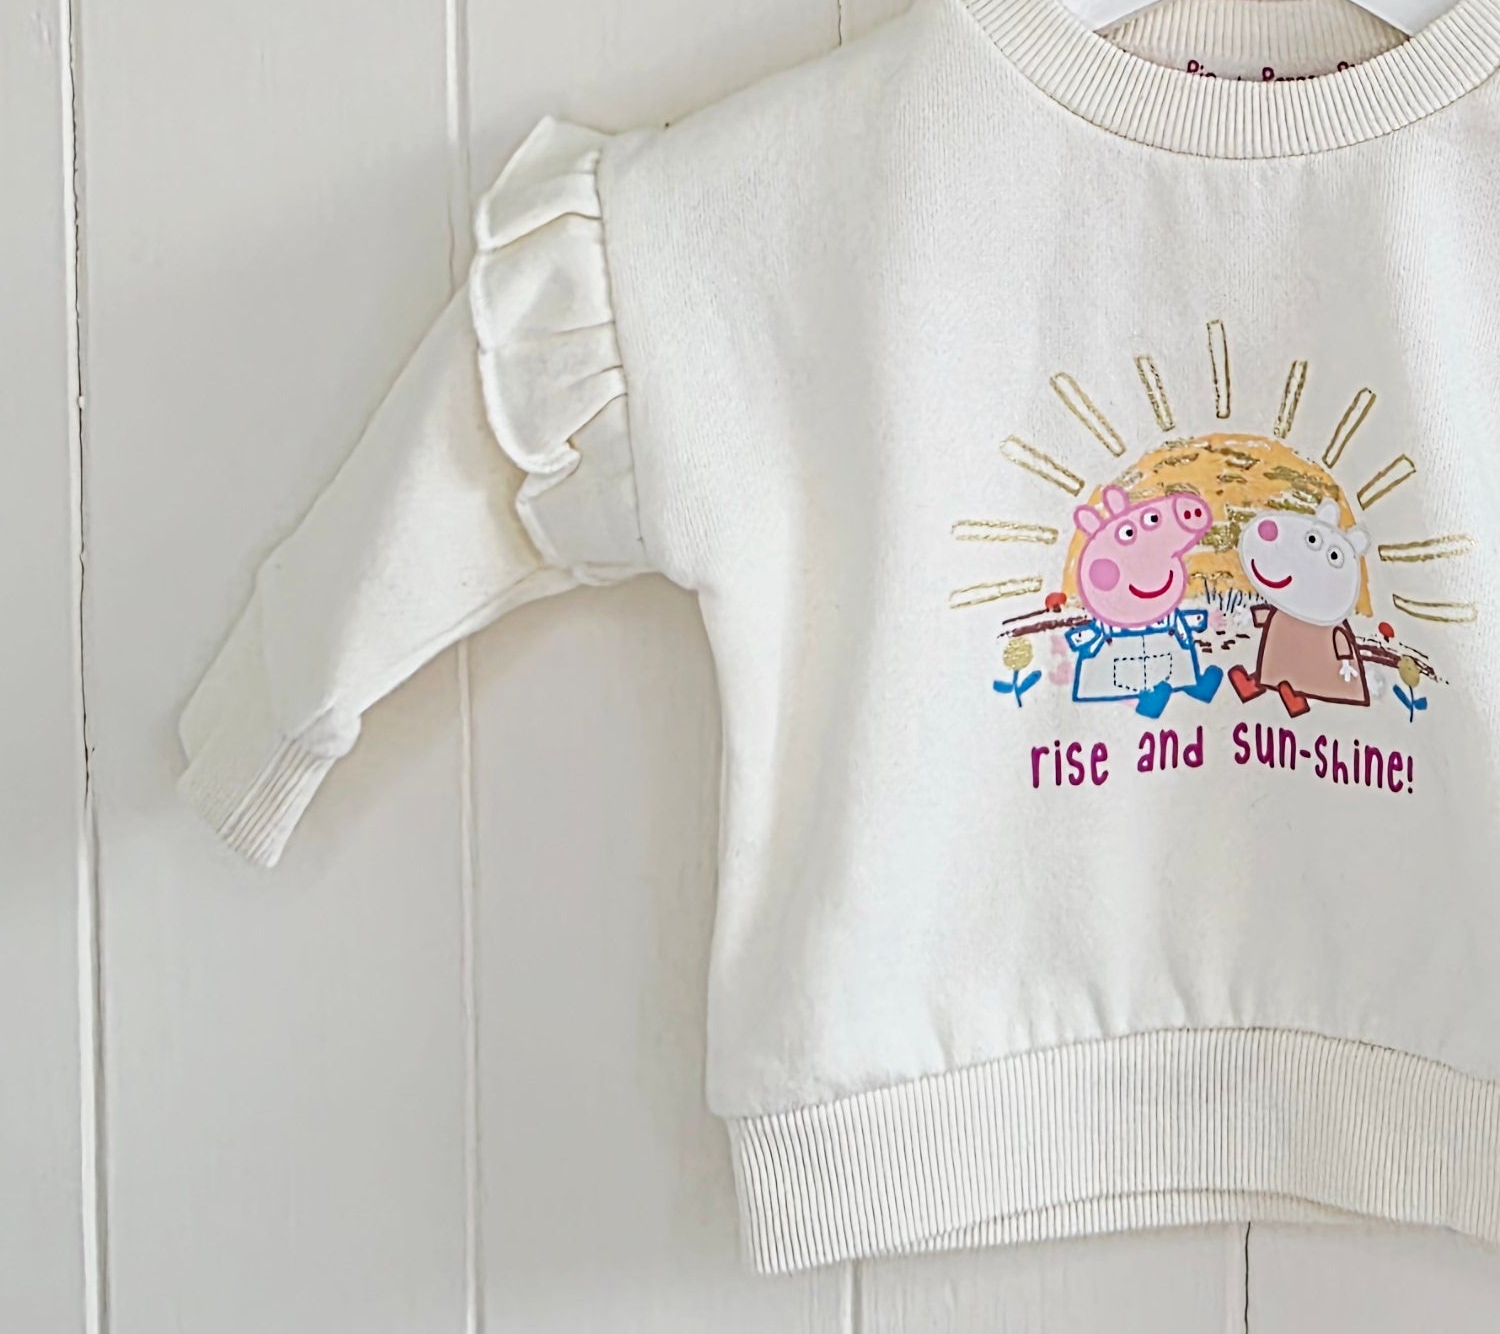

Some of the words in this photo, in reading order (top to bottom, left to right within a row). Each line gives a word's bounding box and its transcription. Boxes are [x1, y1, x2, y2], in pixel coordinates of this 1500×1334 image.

[1030, 739, 1109, 789] rise
[1136, 725, 1204, 773] and
[1232, 722, 1414, 794] sun-shine!
